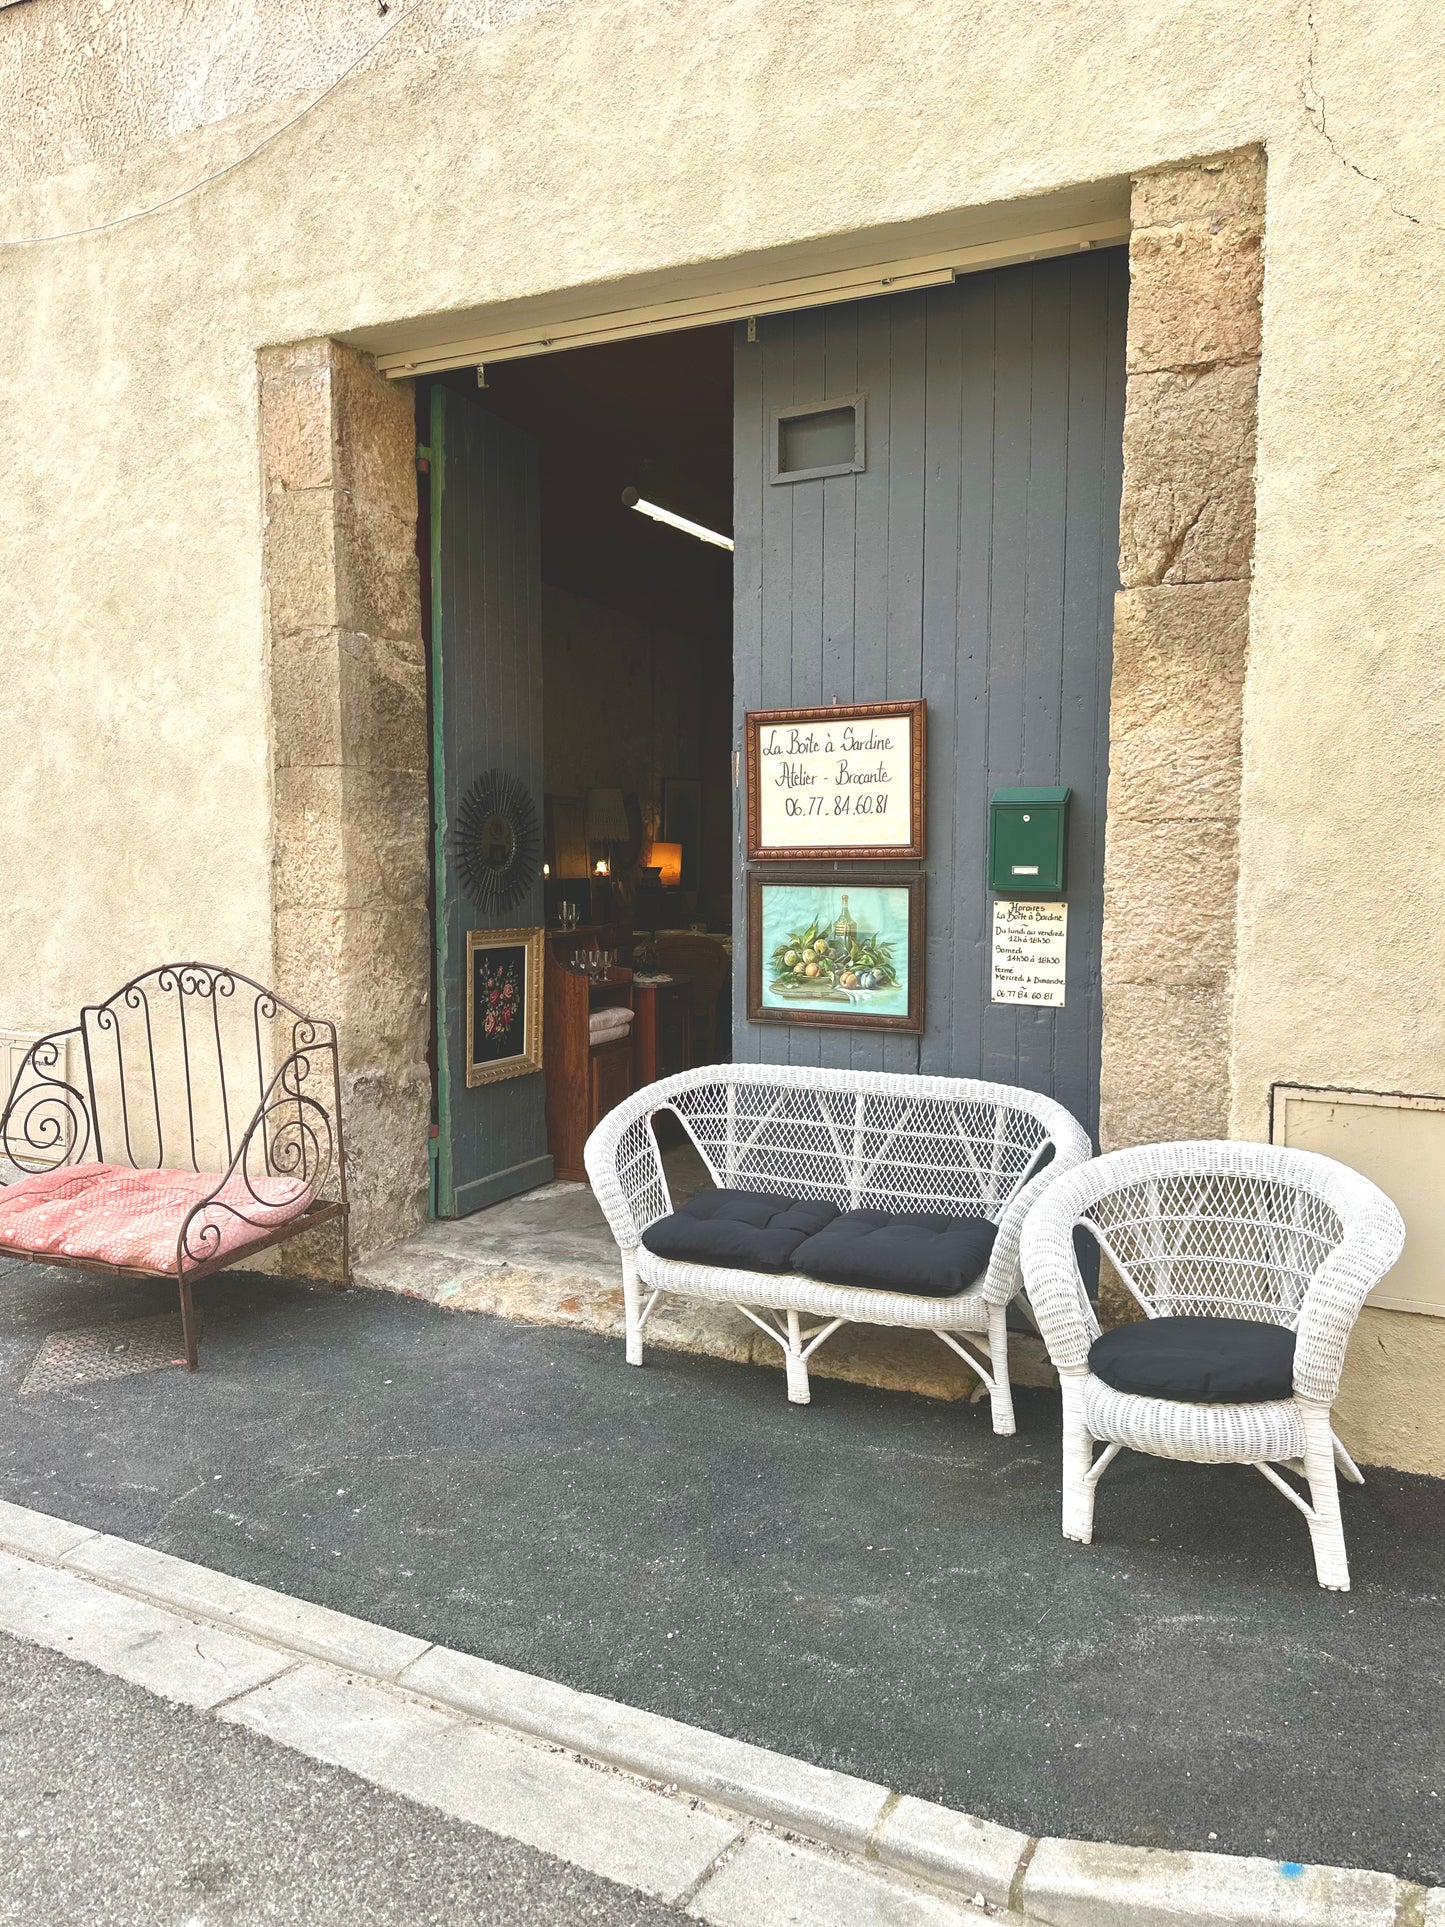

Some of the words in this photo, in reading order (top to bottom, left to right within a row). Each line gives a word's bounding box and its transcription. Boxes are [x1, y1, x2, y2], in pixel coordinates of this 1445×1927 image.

[763, 730, 784, 756] La
[786, 728, 820, 755] Boîte
[825, 733, 836, 753] à
[840, 726, 895, 751] Sardine
[774, 761, 818, 789] Atelier
[834, 759, 893, 786] Brocante
[1009, 902, 1046, 912] Horaires
[1028, 912, 1034, 920] à
[1036, 912, 1064, 922] Sardine
[995, 926, 1006, 935] Du
[995, 944, 1022, 954] Samedi
[1034, 976, 1066, 985] Dimanche
